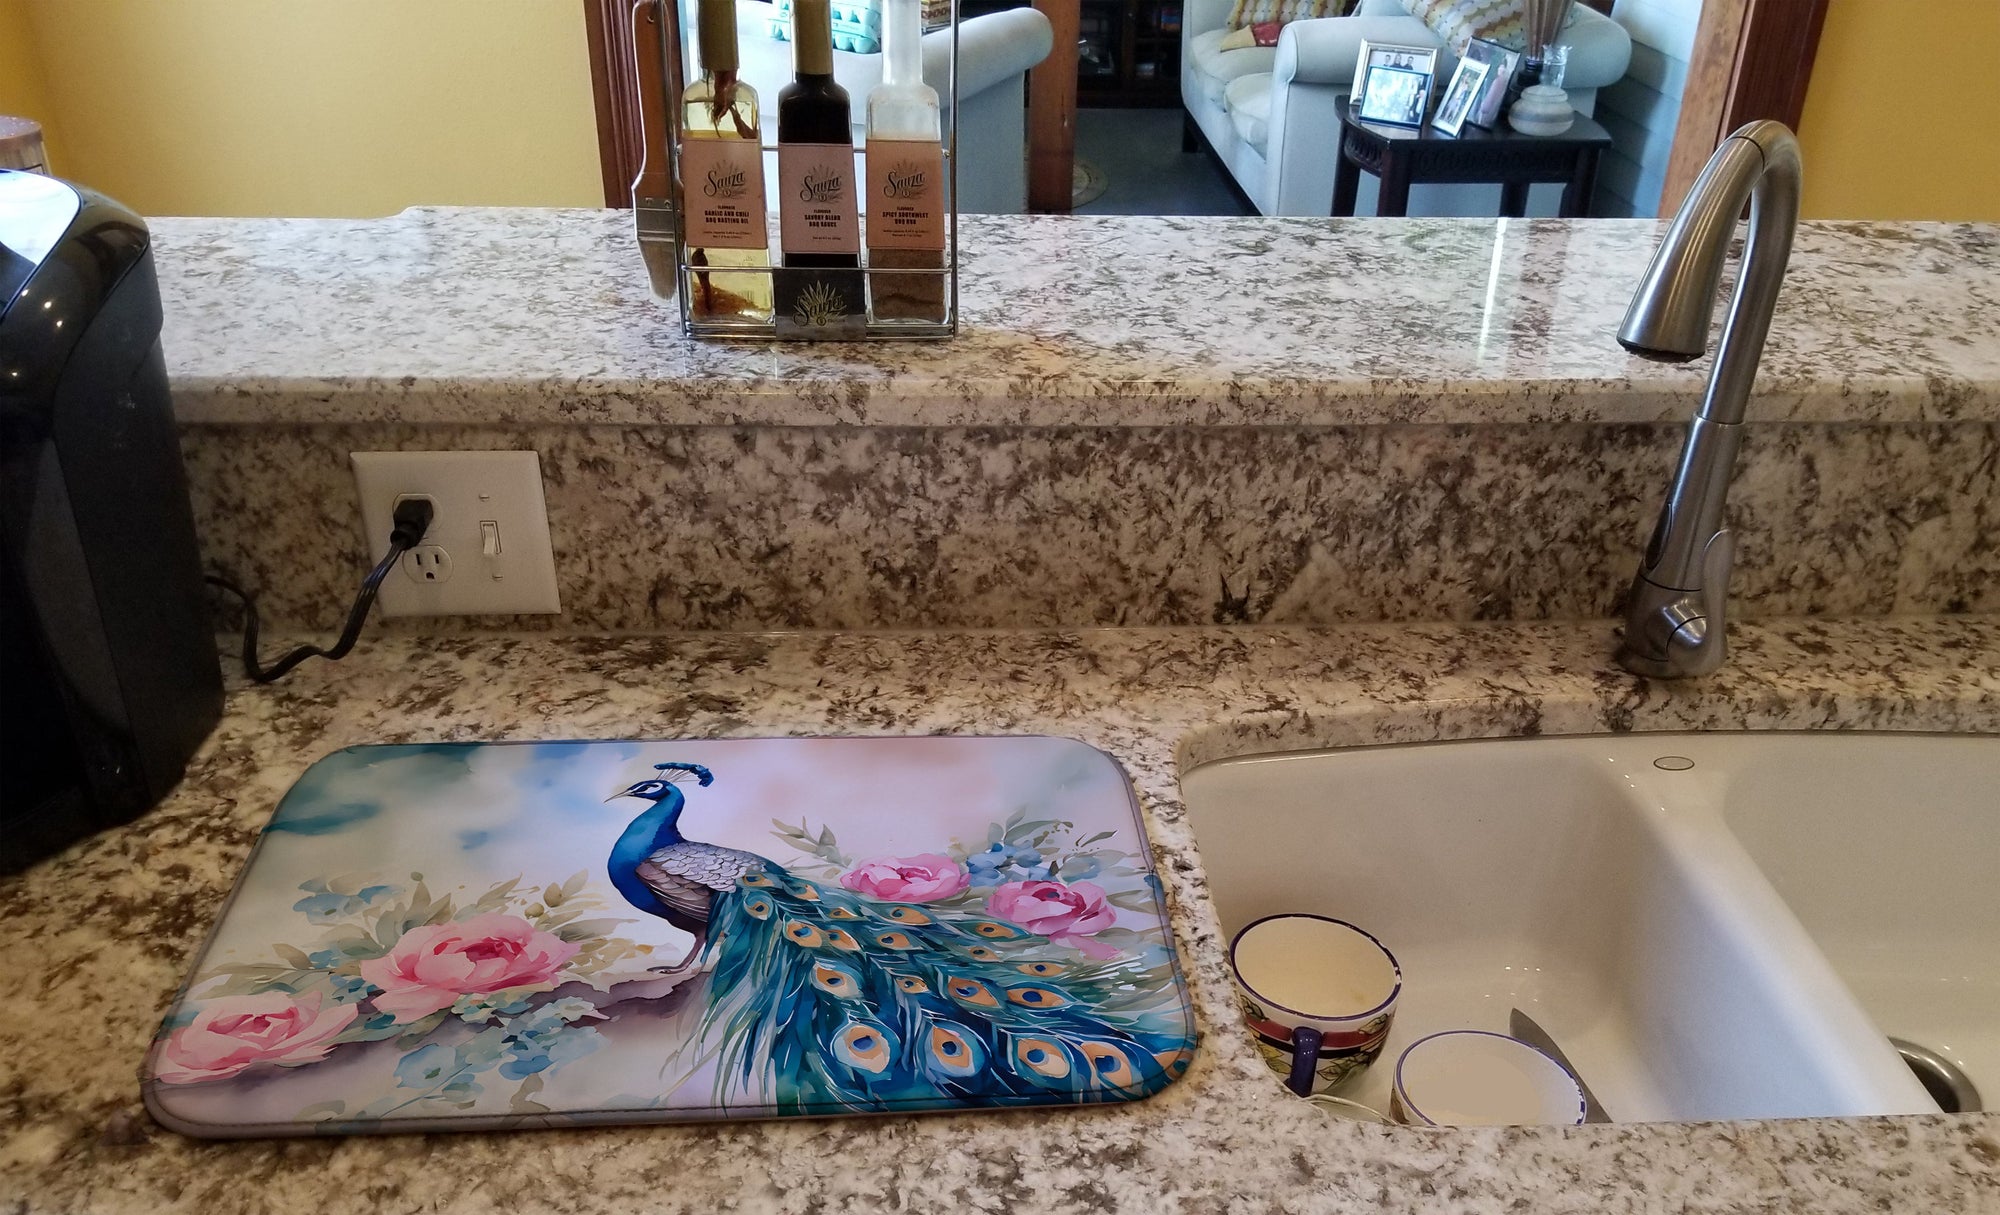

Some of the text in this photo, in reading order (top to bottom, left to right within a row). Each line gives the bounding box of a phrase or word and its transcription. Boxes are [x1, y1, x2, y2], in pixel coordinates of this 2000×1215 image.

[703, 170, 745, 198] Sauza
[800, 175, 842, 202] Sauza
[883, 171, 925, 198] Sauza
